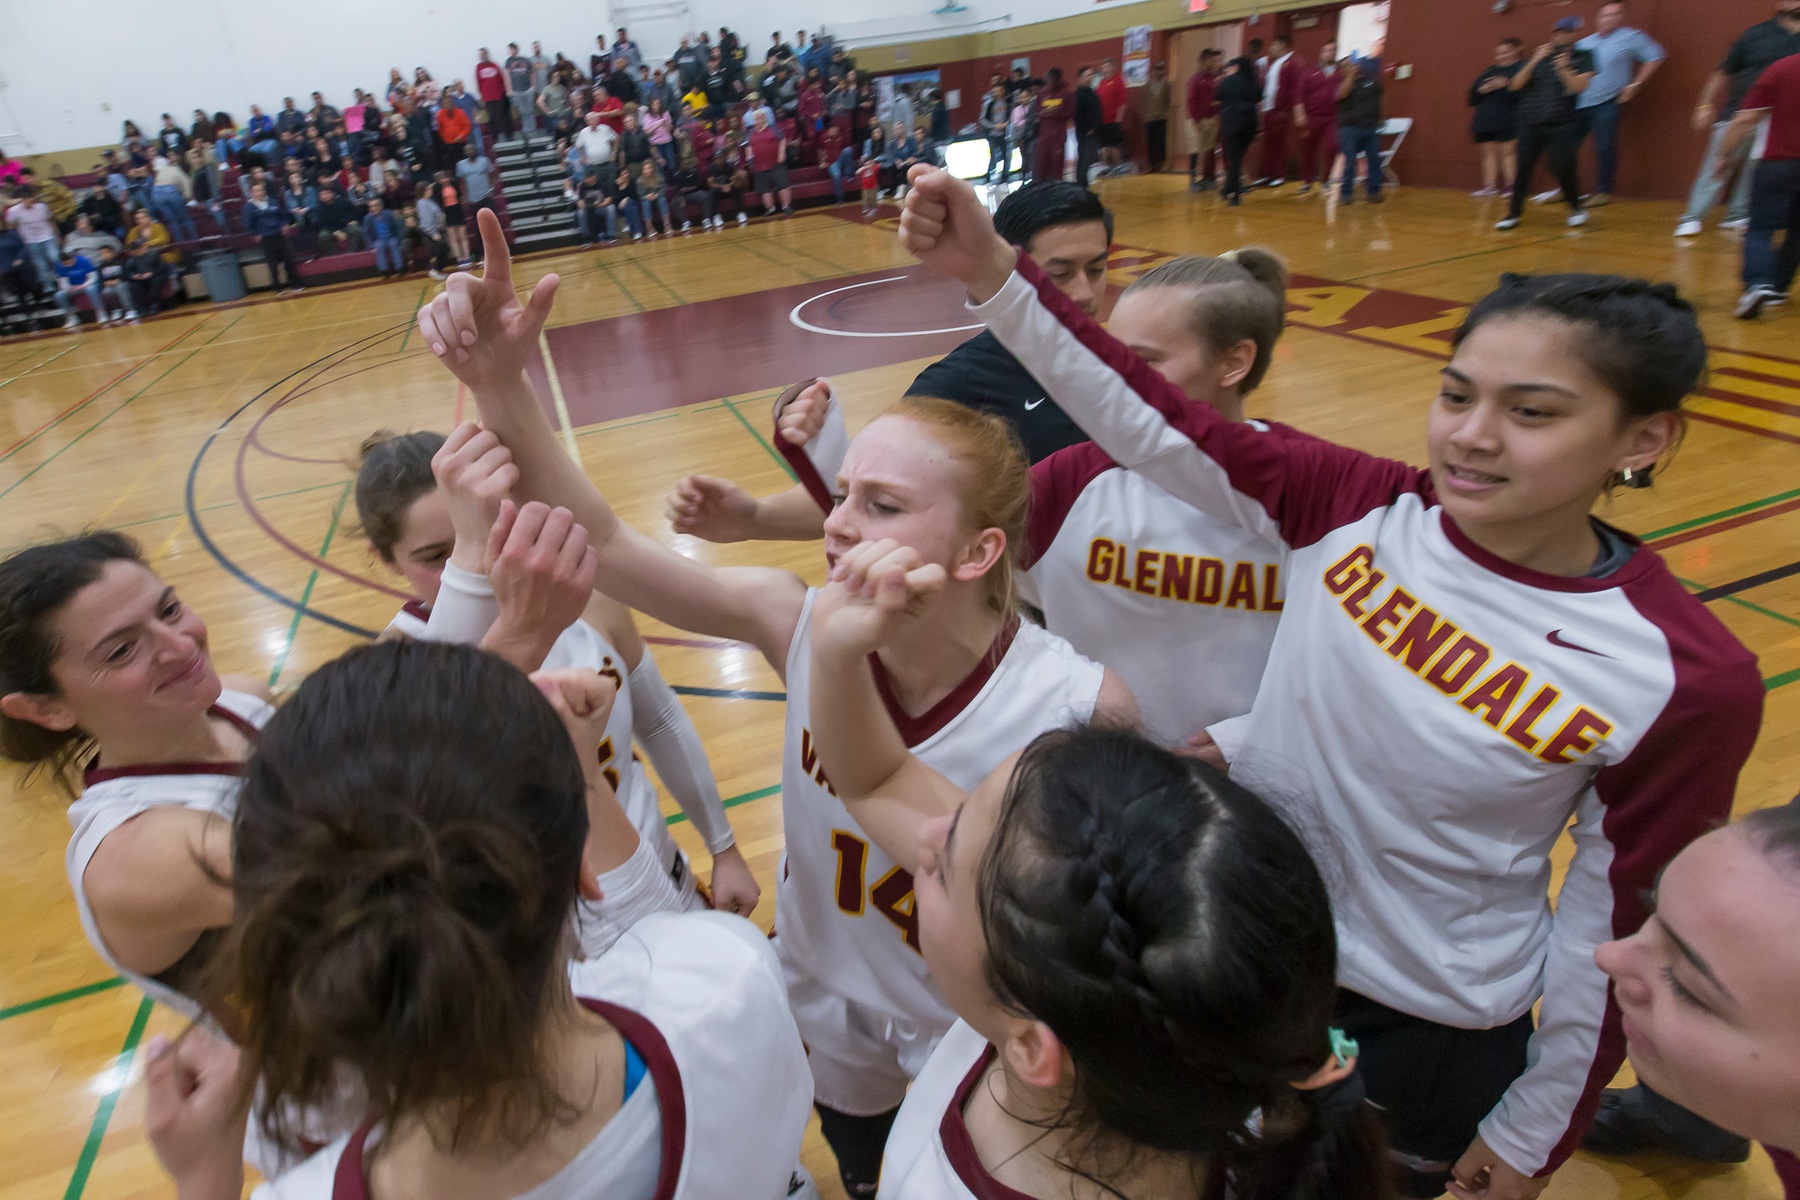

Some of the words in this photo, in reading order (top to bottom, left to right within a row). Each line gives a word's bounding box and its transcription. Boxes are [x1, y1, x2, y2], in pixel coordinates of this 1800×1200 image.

[1086, 536, 1285, 613] GLENDAL
[1323, 543, 1614, 765] GLENDALE
[831, 828, 924, 957] 14
